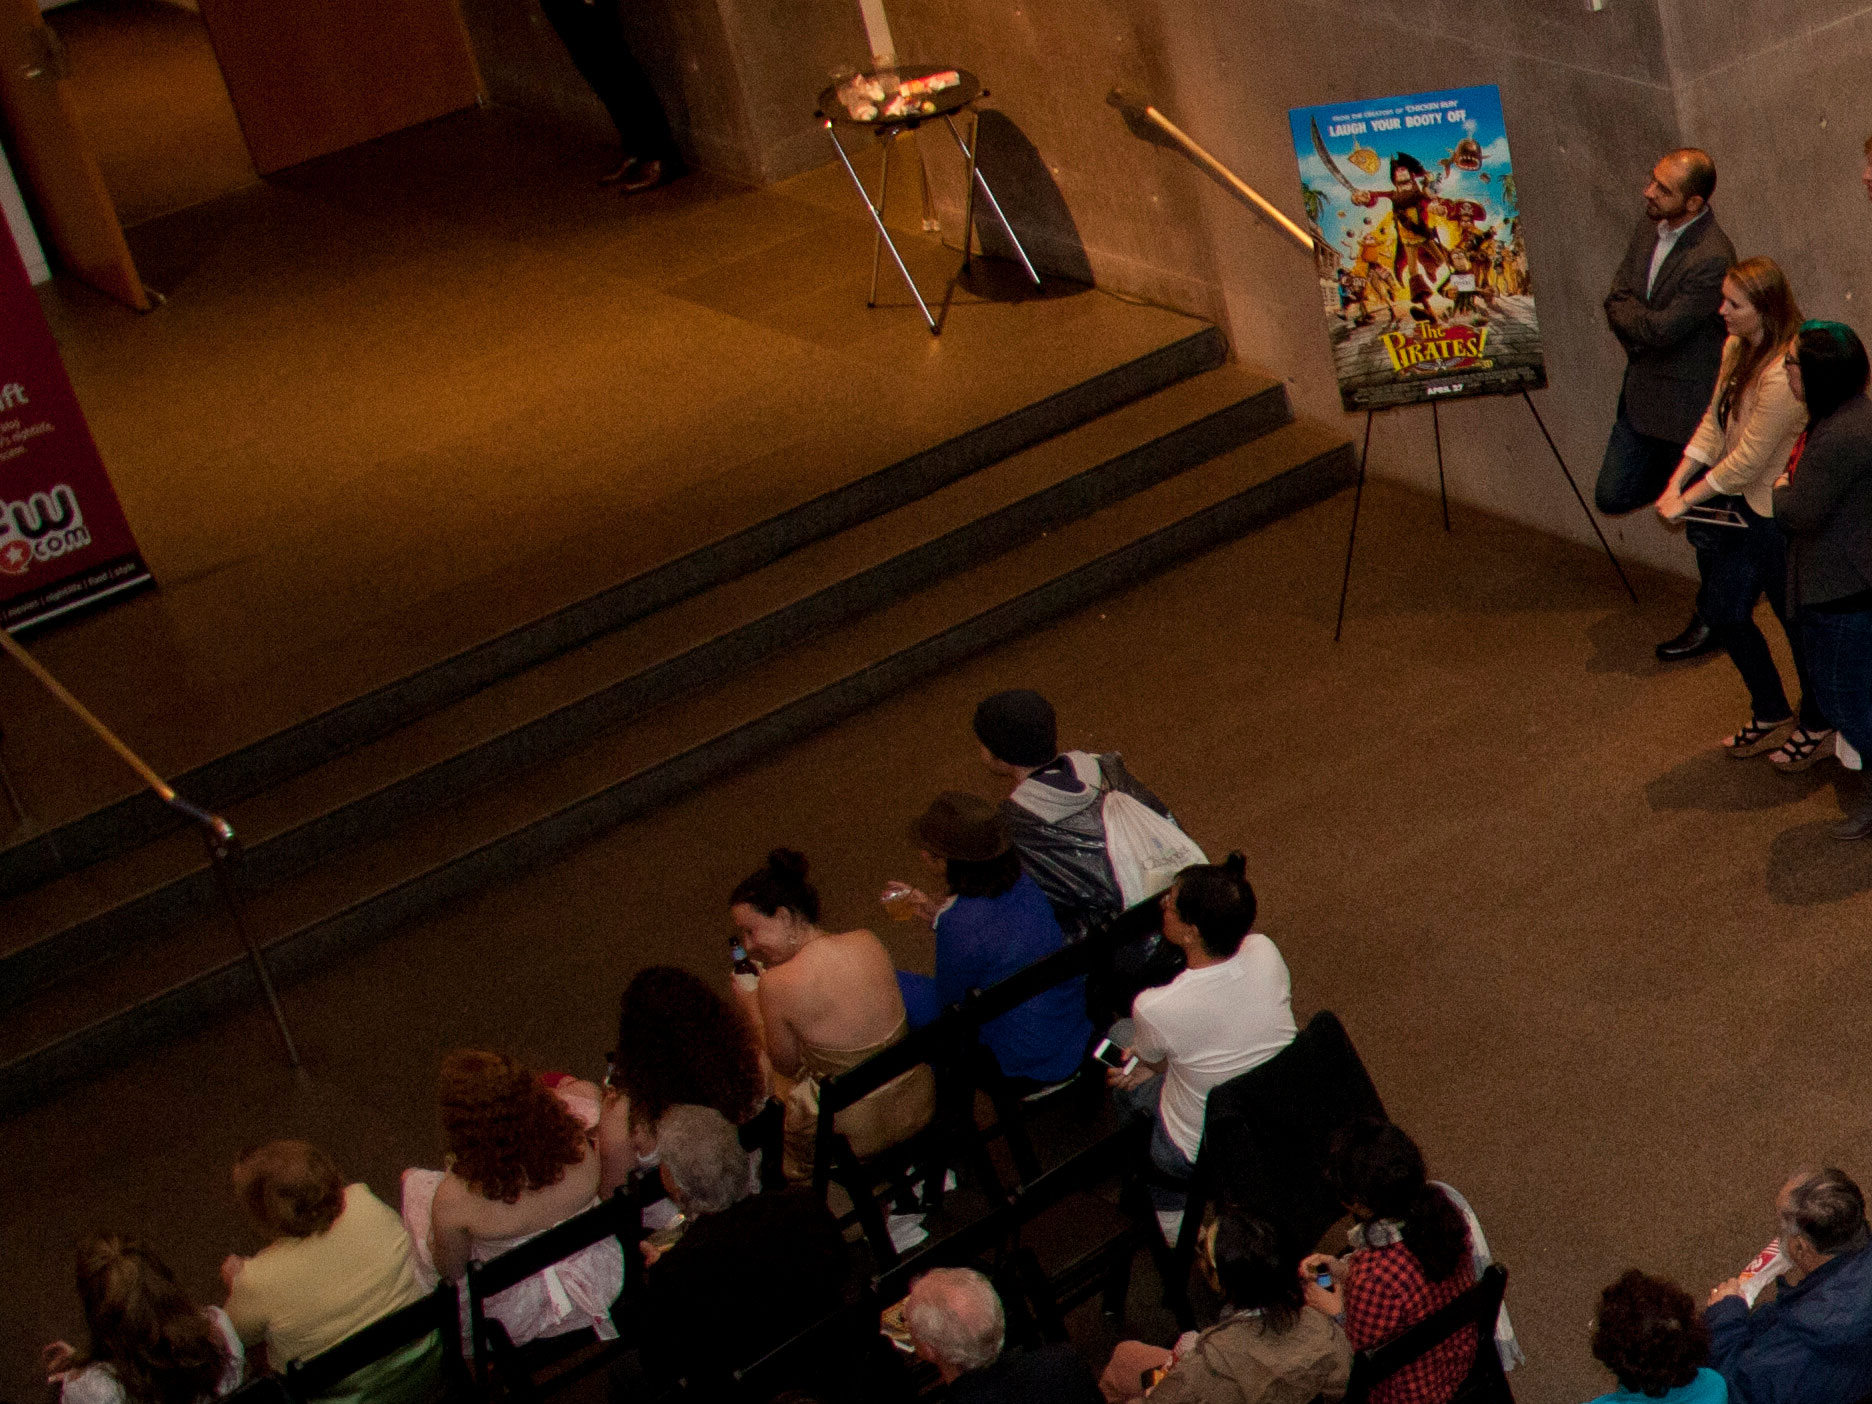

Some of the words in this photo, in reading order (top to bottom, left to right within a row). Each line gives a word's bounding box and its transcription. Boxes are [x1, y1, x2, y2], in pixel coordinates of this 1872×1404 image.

[1328, 121, 1367, 138] LAUGH
[1371, 118, 1401, 132] YOUR
[1405, 112, 1443, 129] BOOTY
[1447, 109, 1467, 123] OFF
[1416, 319, 1446, 339] The
[1378, 327, 1489, 372] PIRATES!
